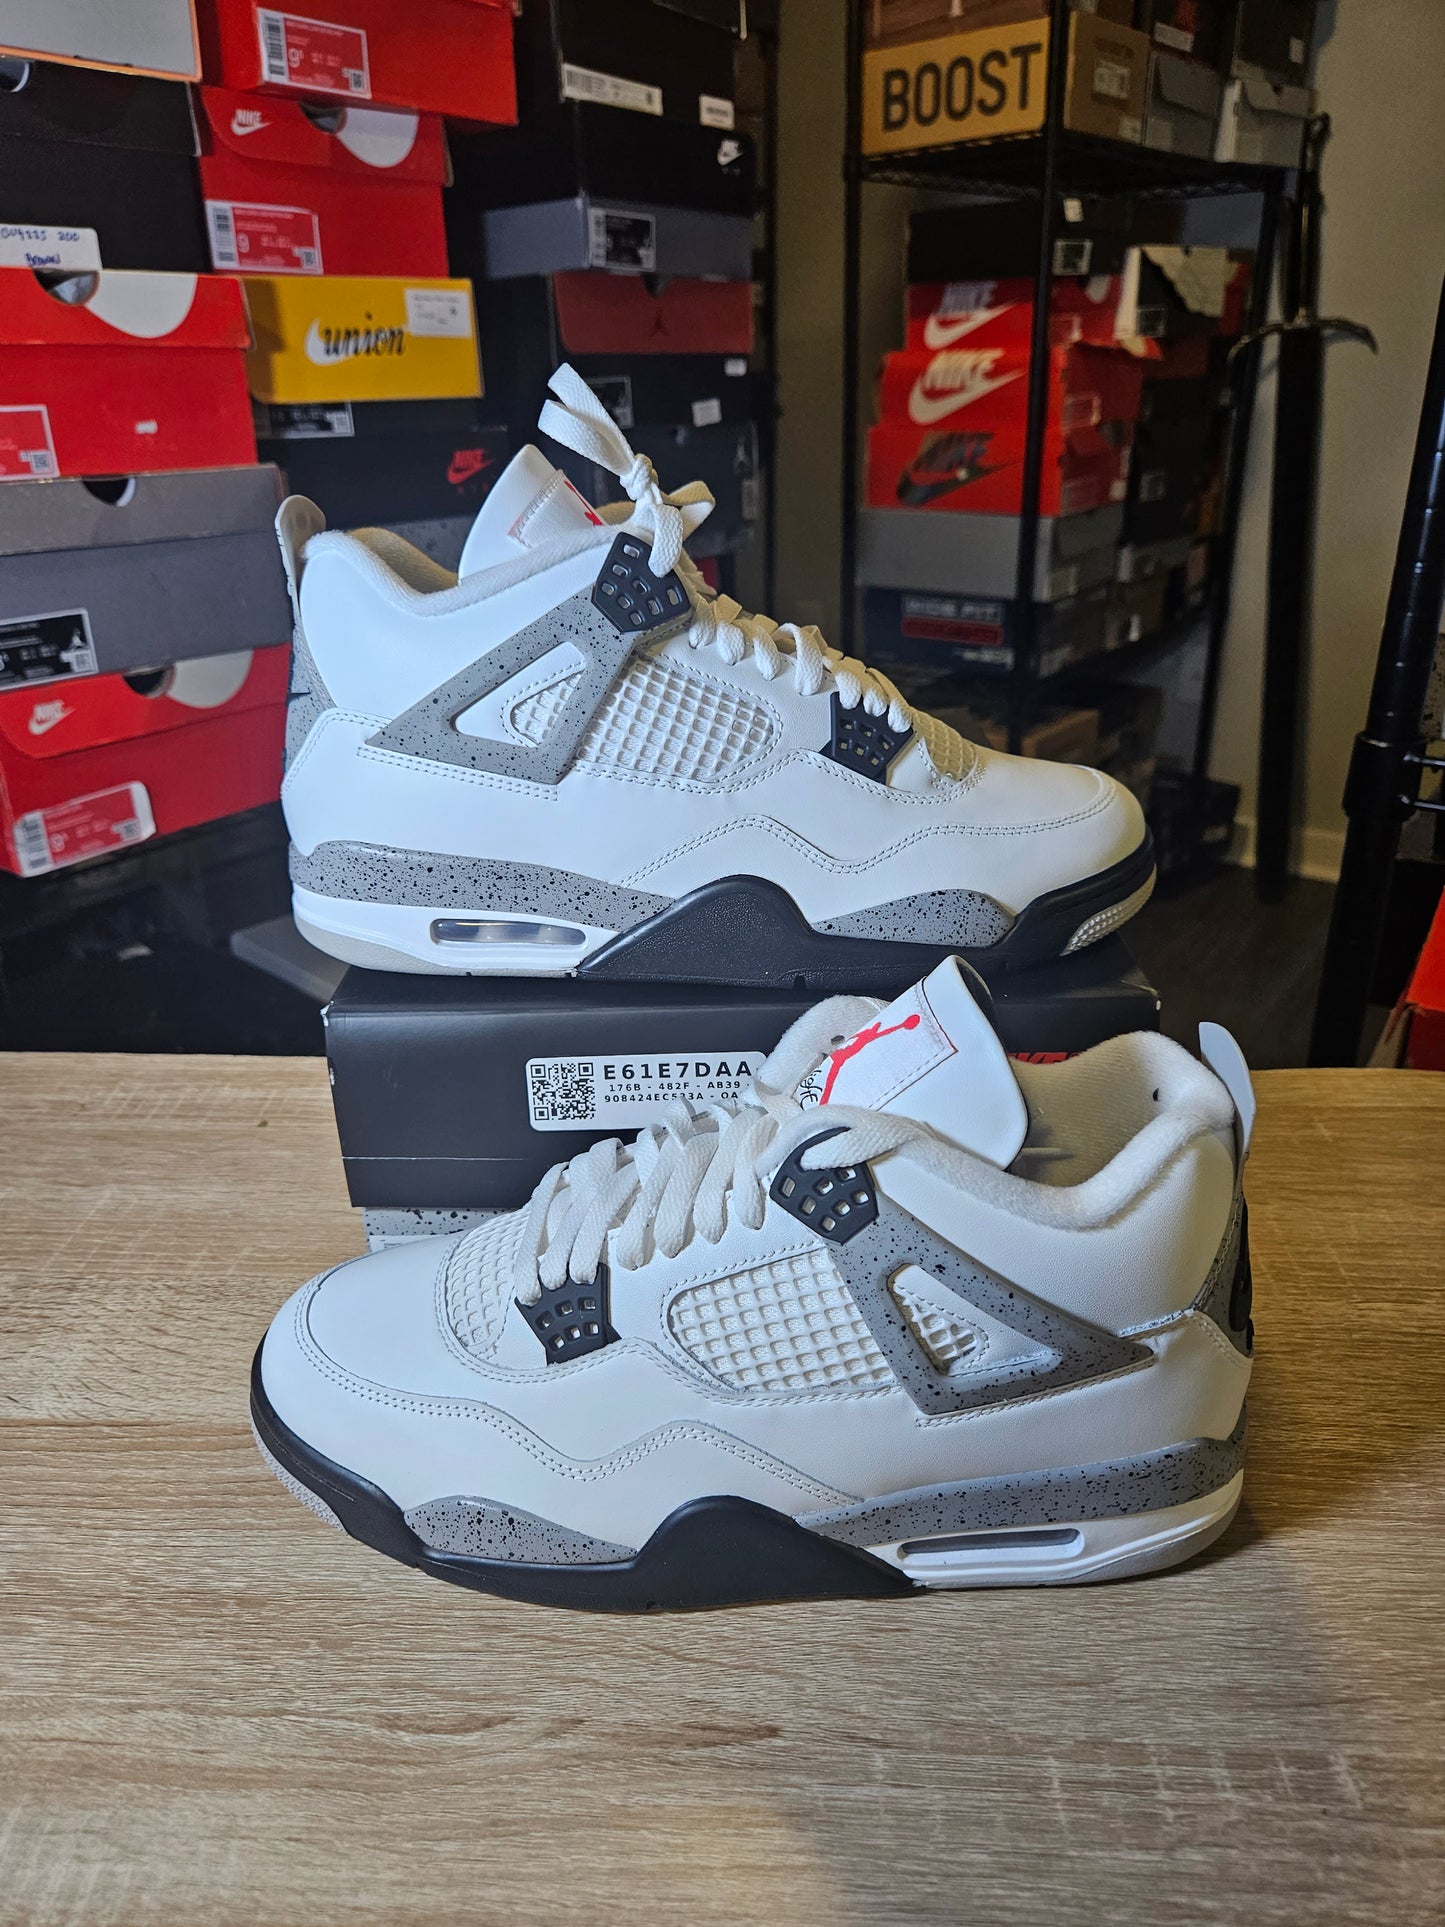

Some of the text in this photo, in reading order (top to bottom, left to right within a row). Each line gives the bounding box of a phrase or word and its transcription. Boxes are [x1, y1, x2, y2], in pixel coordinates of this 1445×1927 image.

[882, 42, 1042, 133] BOOST
[235, 109, 262, 125] NIKE
[941, 281, 999, 318] NIKE
[323, 311, 406, 357] union
[919, 348, 1005, 390] NIKE
[603, 1061, 752, 1080] E61E7DAA
[609, 1083, 641, 1092] 176B
[658, 1082, 690, 1091] 482F
[707, 1080, 741, 1090] AB39
